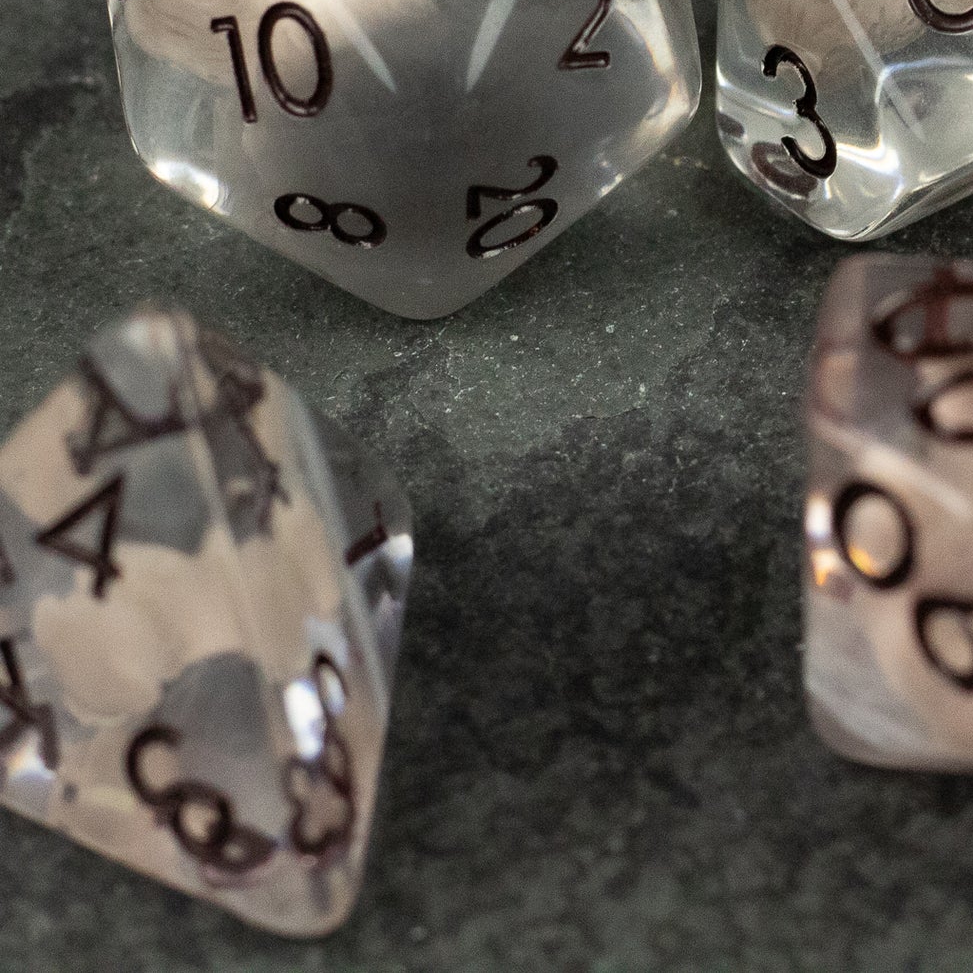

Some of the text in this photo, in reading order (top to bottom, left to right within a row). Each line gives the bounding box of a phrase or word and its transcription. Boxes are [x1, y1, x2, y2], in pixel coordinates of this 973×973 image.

[210, 0, 333, 125] 10
[761, 44, 837, 180] 3
[273, 191, 388, 250] 8
[465, 154, 560, 260] 20
